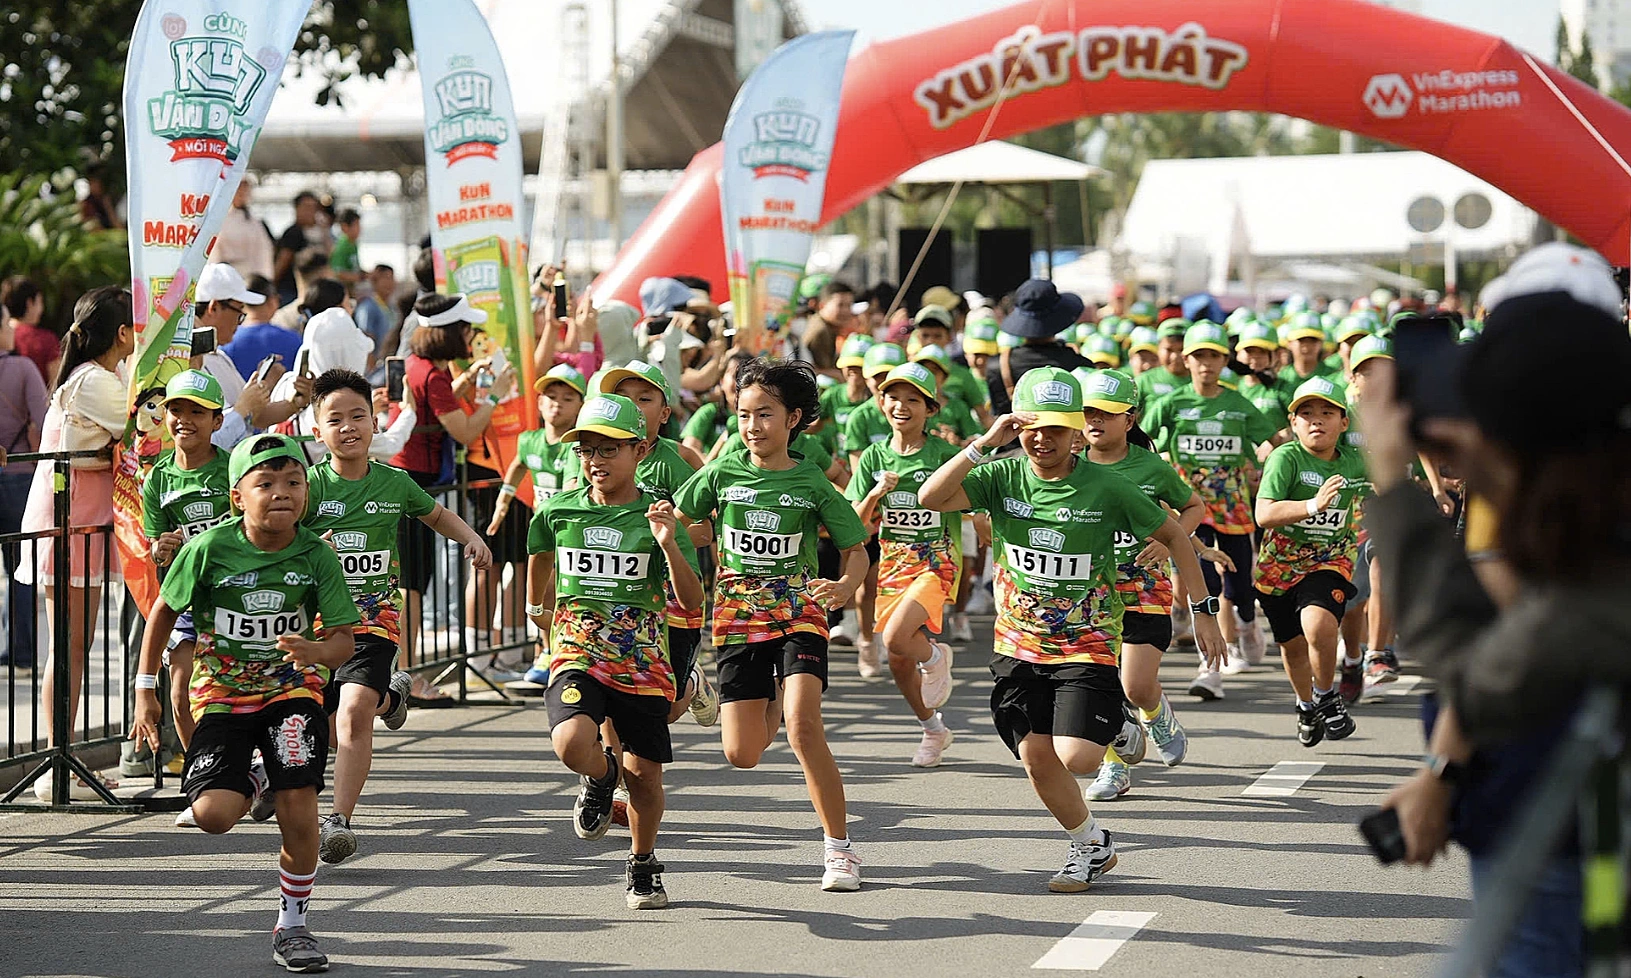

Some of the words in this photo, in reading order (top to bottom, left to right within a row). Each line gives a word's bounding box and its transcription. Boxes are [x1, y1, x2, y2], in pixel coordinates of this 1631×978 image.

[922, 32, 1071, 122] XUẤT
[1085, 30, 1240, 82] PHÁT
[1412, 70, 1519, 91] VnExpress
[1419, 91, 1521, 114] Marathon
[459, 183, 491, 200] KUN
[437, 203, 514, 228] MARATHON
[1186, 438, 1233, 451] 15094
[185, 503, 213, 519] KUN
[886, 511, 933, 527] 5232
[333, 533, 367, 549] KUN
[584, 528, 622, 549] KUN
[730, 531, 791, 556] 15001
[1029, 530, 1065, 551] KUN
[566, 551, 639, 576] 15112
[1012, 548, 1077, 576] 15111
[243, 592, 283, 612] KUN
[227, 613, 301, 639] 15100
